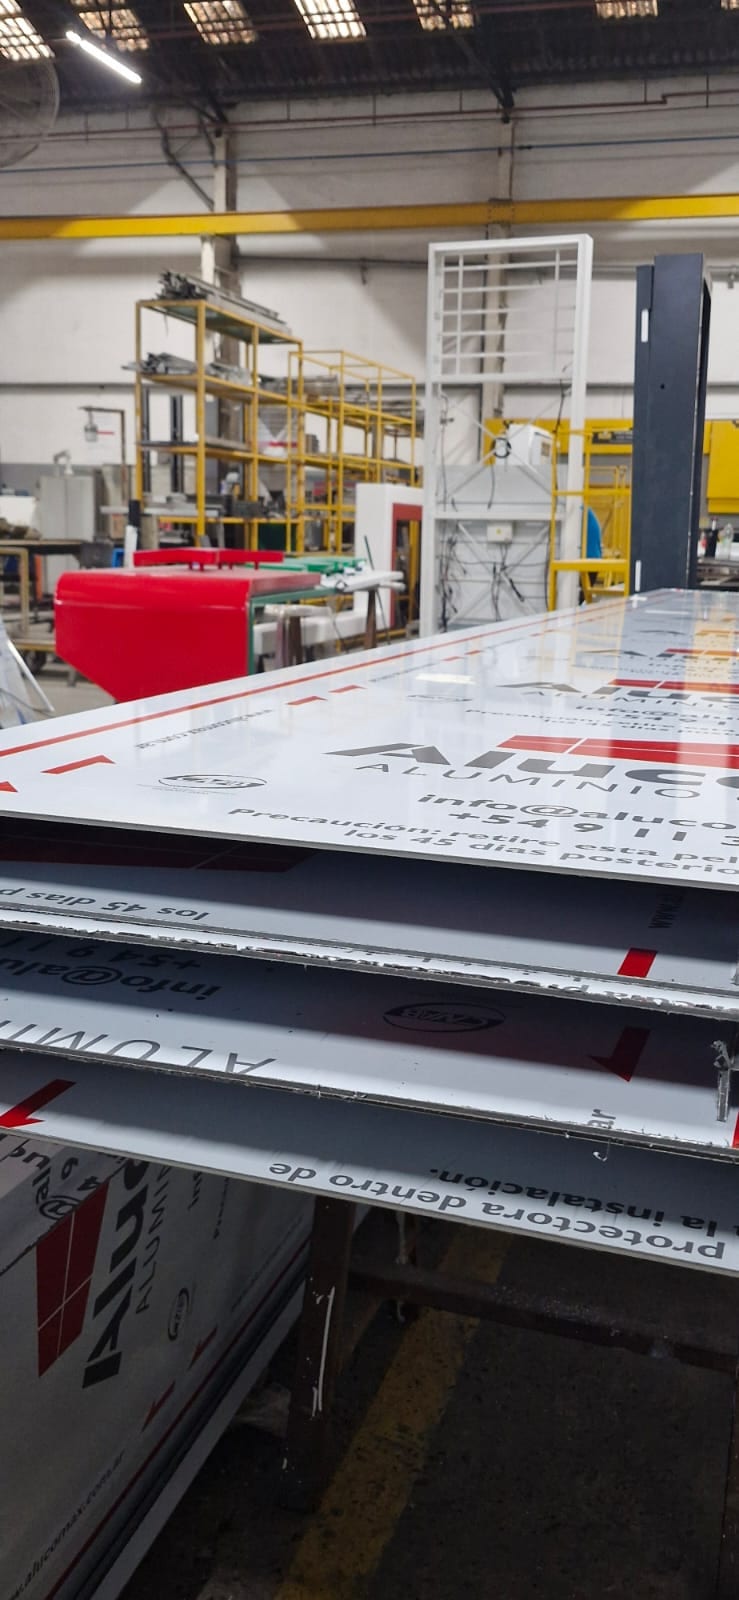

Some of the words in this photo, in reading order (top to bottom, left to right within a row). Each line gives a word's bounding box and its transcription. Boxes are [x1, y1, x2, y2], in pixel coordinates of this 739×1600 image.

[354, 762, 701, 799] ALUMINIO
[448, 812, 550, 829] +54
[573, 823, 604, 833] 9
[344, 829, 397, 842] los
[409, 837, 457, 847] 45
[449, 831, 561, 848] retire
[574, 843, 660, 858] esta
[100, 901, 147, 913] 45
[156, 906, 209, 921] los
[268, 1163, 317, 1182] de
[328, 1174, 468, 1211] dentro
[429, 1168, 666, 1227] instalación.
[481, 1202, 727, 1260] protectora
[680, 1214, 718, 1237] la
